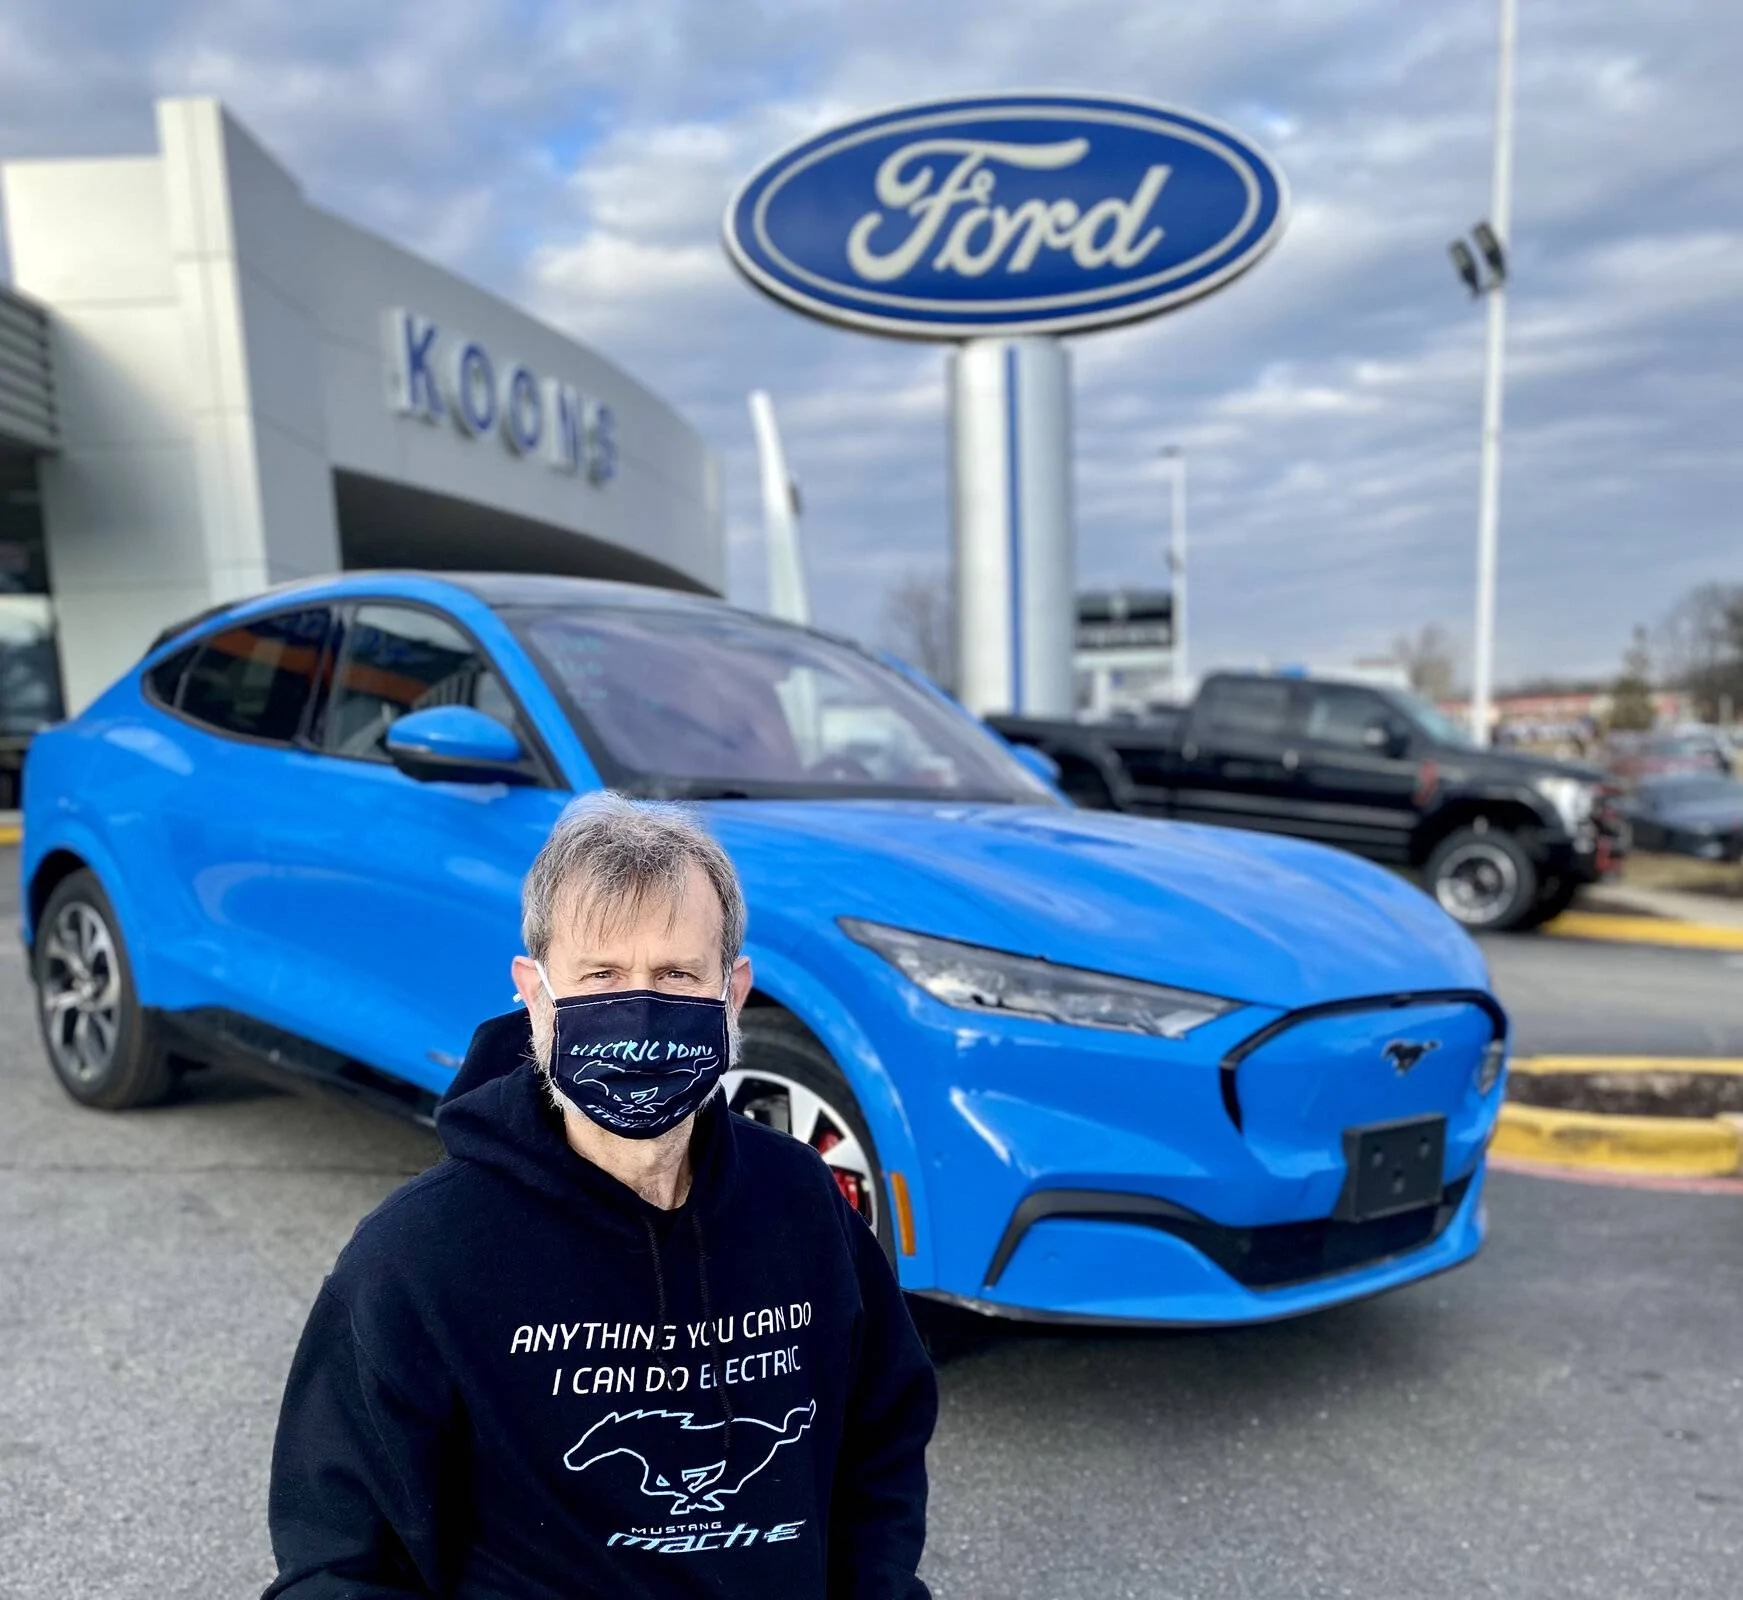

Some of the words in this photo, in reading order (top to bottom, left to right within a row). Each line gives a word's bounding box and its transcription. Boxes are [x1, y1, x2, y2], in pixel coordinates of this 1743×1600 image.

[846, 137, 1172, 281] Ford
[392, 310, 618, 482] KOONS
[510, 1323, 676, 1353] ANYTHING
[687, 1316, 733, 1348] YOU
[743, 1306, 786, 1338] CAN
[790, 1302, 811, 1328] DO
[553, 1369, 562, 1395] I
[573, 1367, 635, 1394] CAN
[646, 1367, 689, 1392] DO
[631, 1521, 723, 1535] MUSTANG
